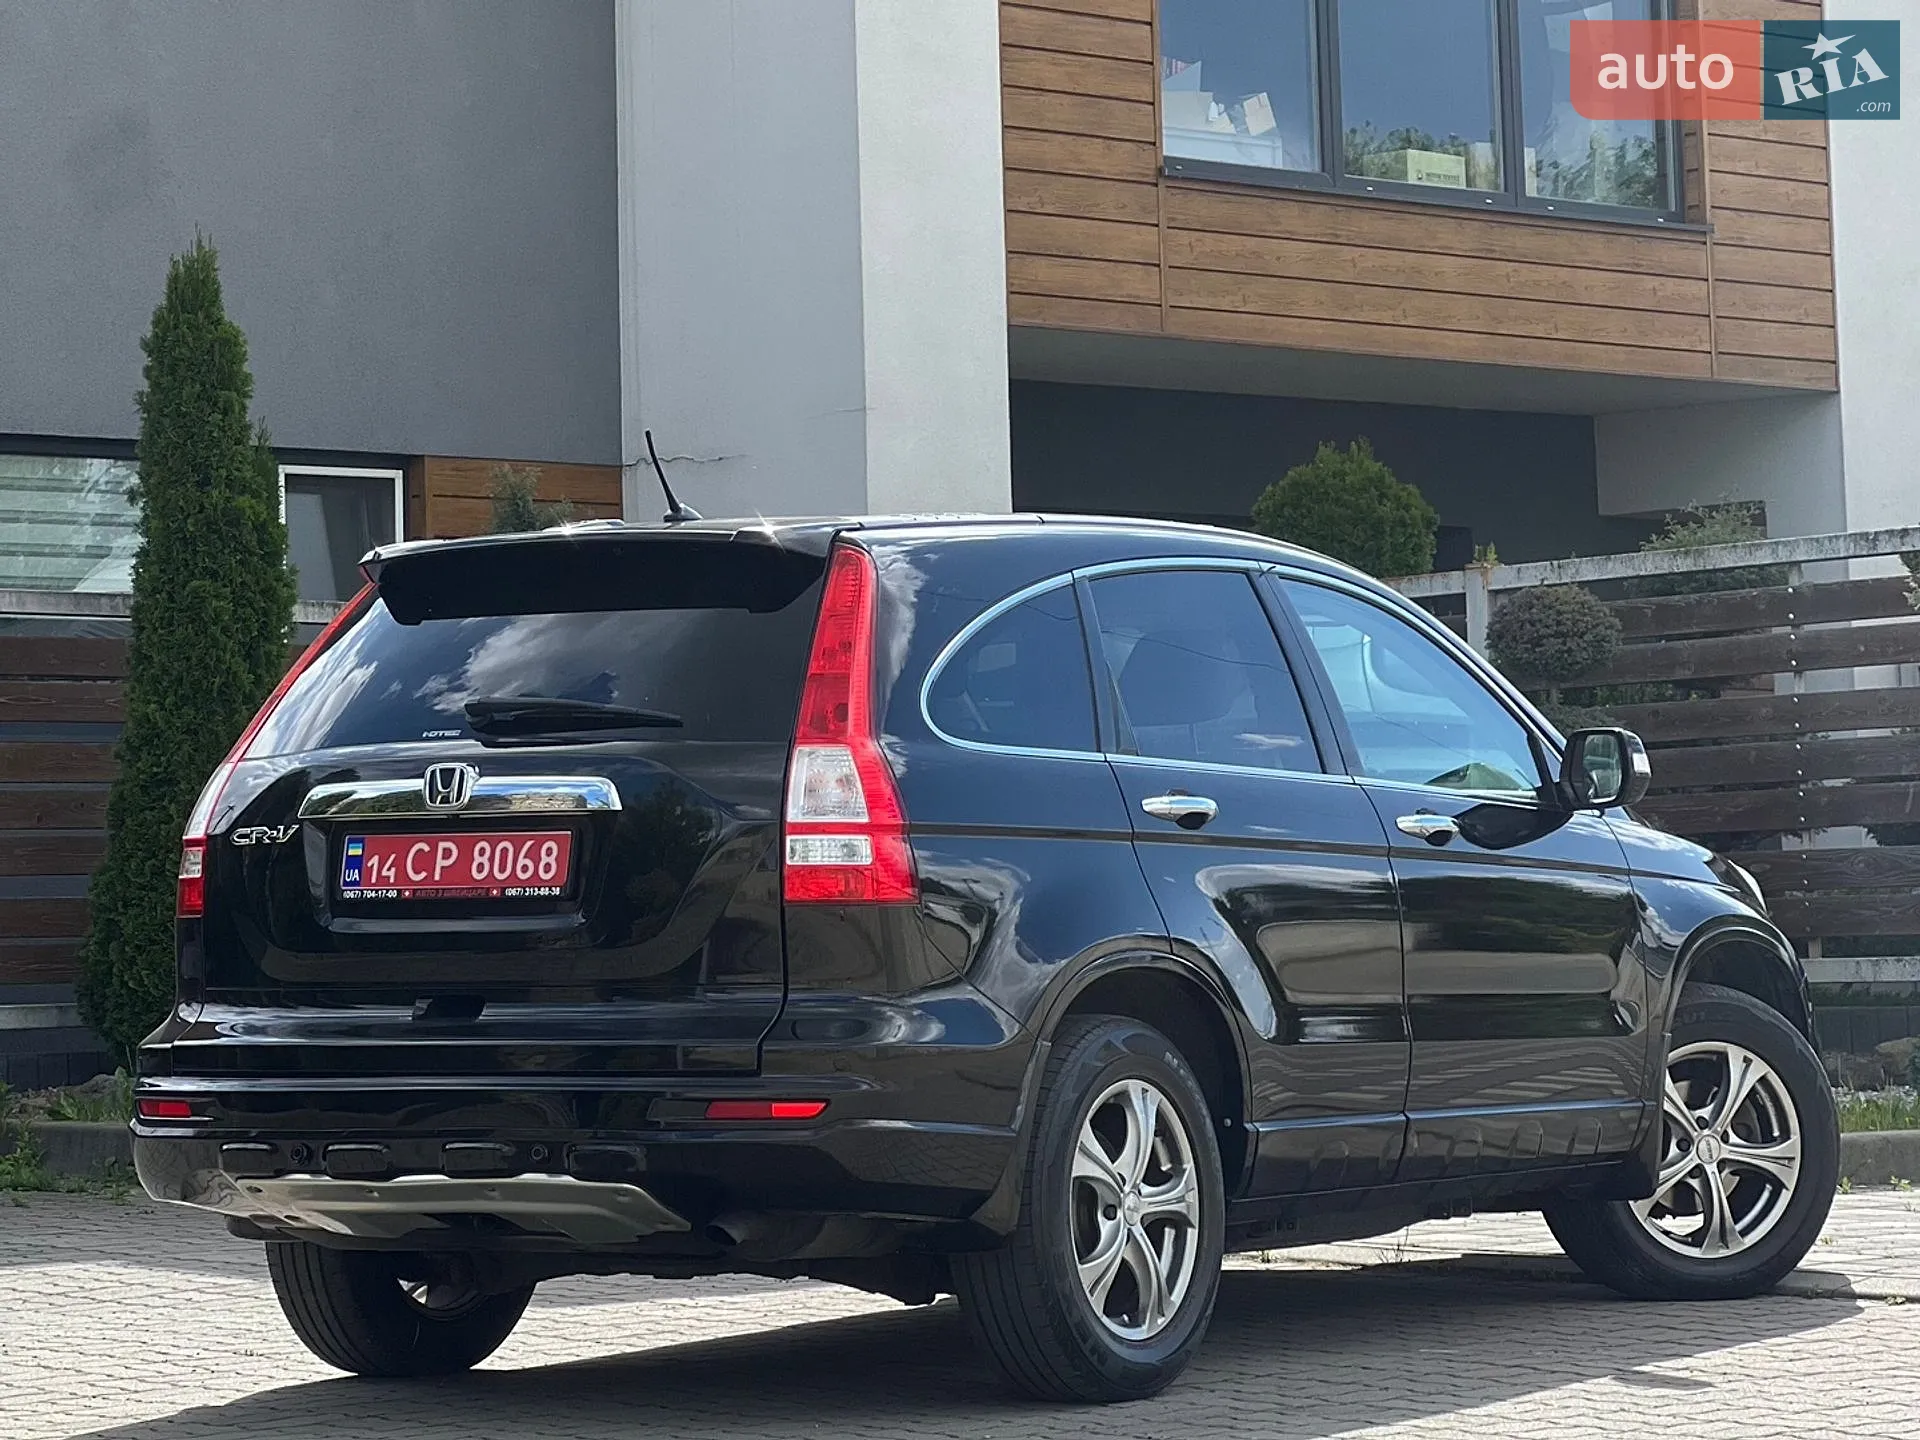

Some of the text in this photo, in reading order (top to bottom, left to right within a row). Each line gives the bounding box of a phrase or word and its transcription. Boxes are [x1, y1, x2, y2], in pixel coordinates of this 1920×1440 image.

[229, 824, 300, 845] CR-V
[366, 840, 559, 884] 14 CP 8068
[345, 868, 361, 882] UA
[343, 890, 361, 899] (067)
[505, 887, 524, 896] (067)
